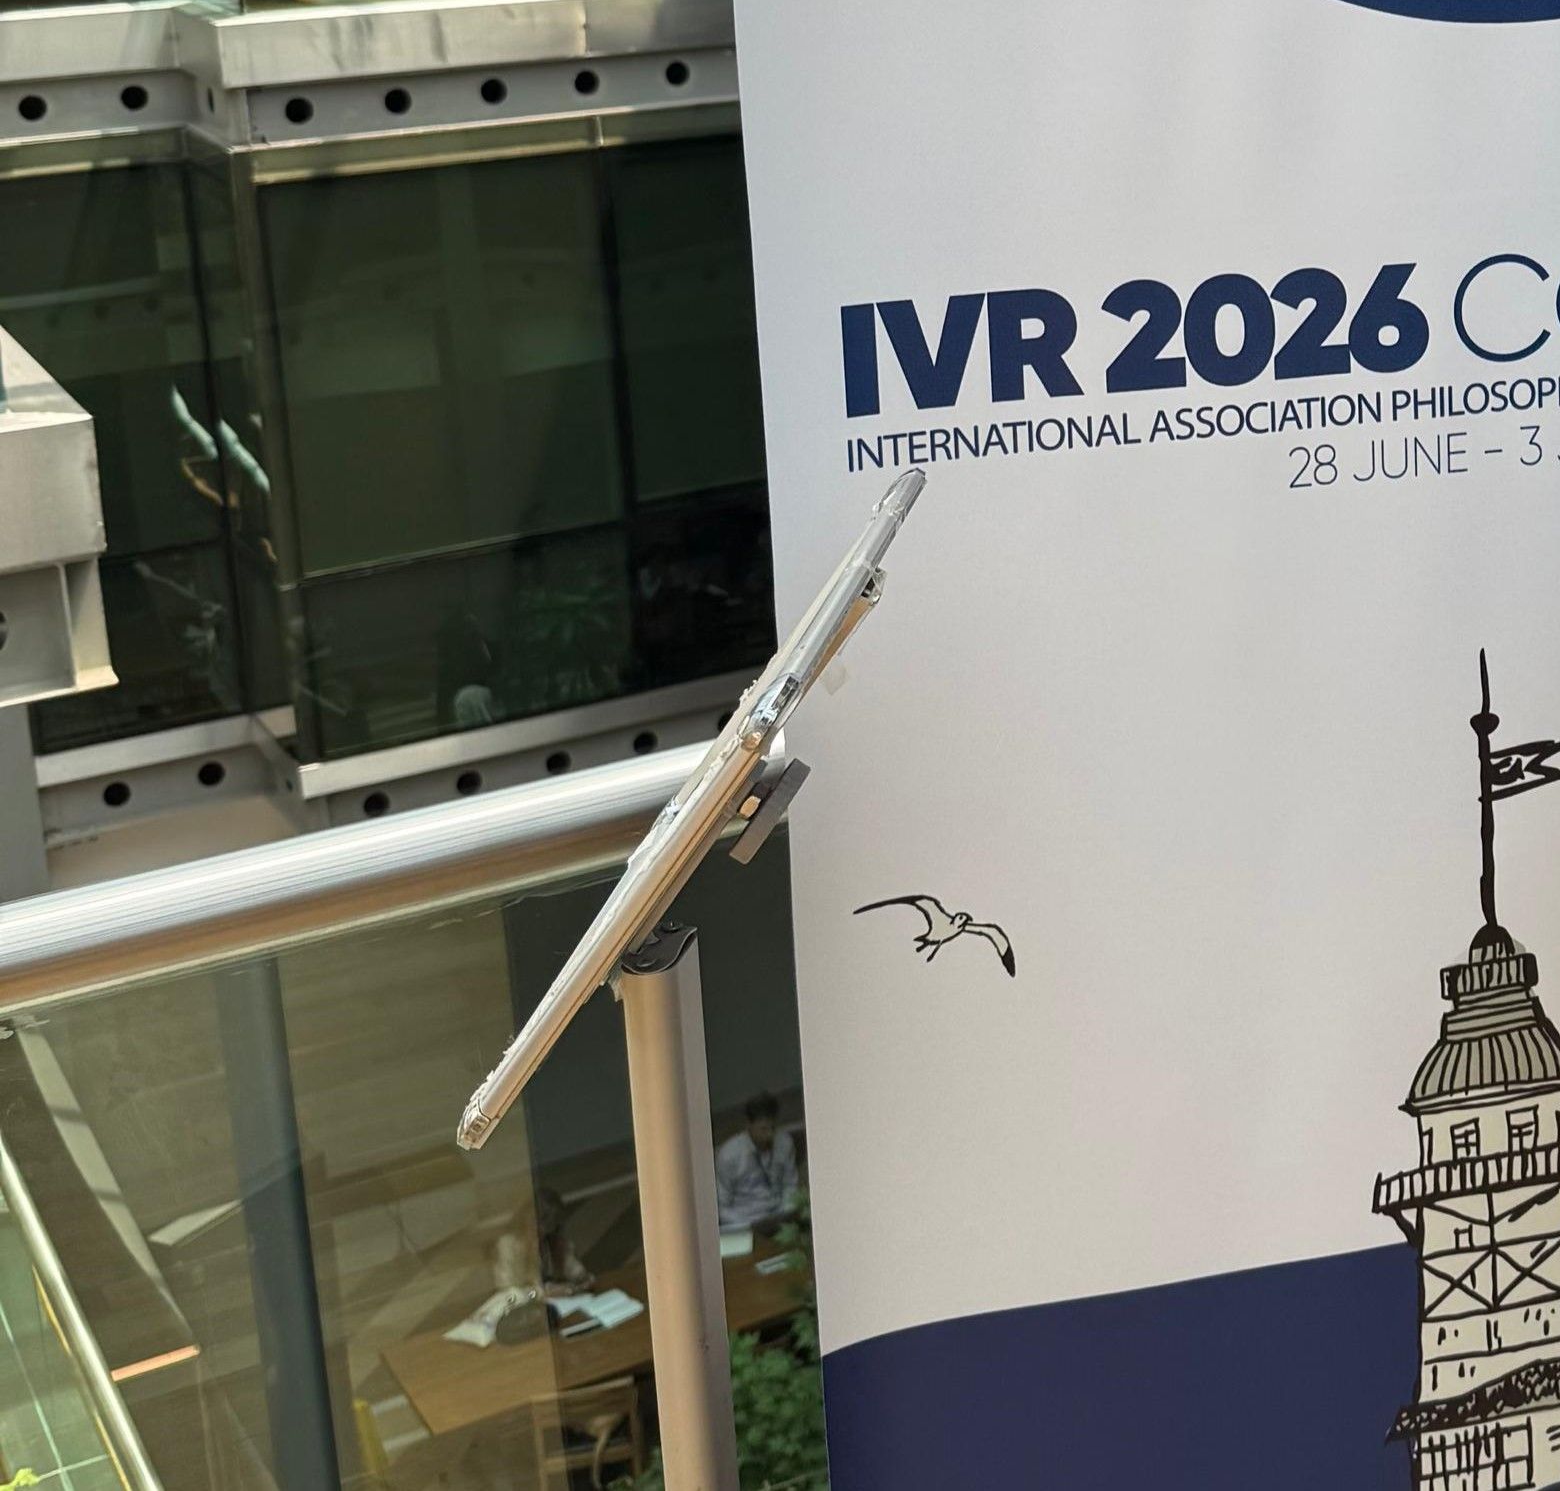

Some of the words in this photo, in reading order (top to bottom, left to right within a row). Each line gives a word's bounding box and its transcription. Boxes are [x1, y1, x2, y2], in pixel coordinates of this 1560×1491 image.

[840, 287, 1084, 419] IVR
[1101, 262, 1430, 395] 2026
[847, 412, 1142, 473] INTERNATIONAL
[1149, 392, 1381, 443] ASSOCIATION
[1289, 444, 1339, 489] 28
[1353, 432, 1468, 482] JUNE
[1519, 425, 1544, 466] 3
